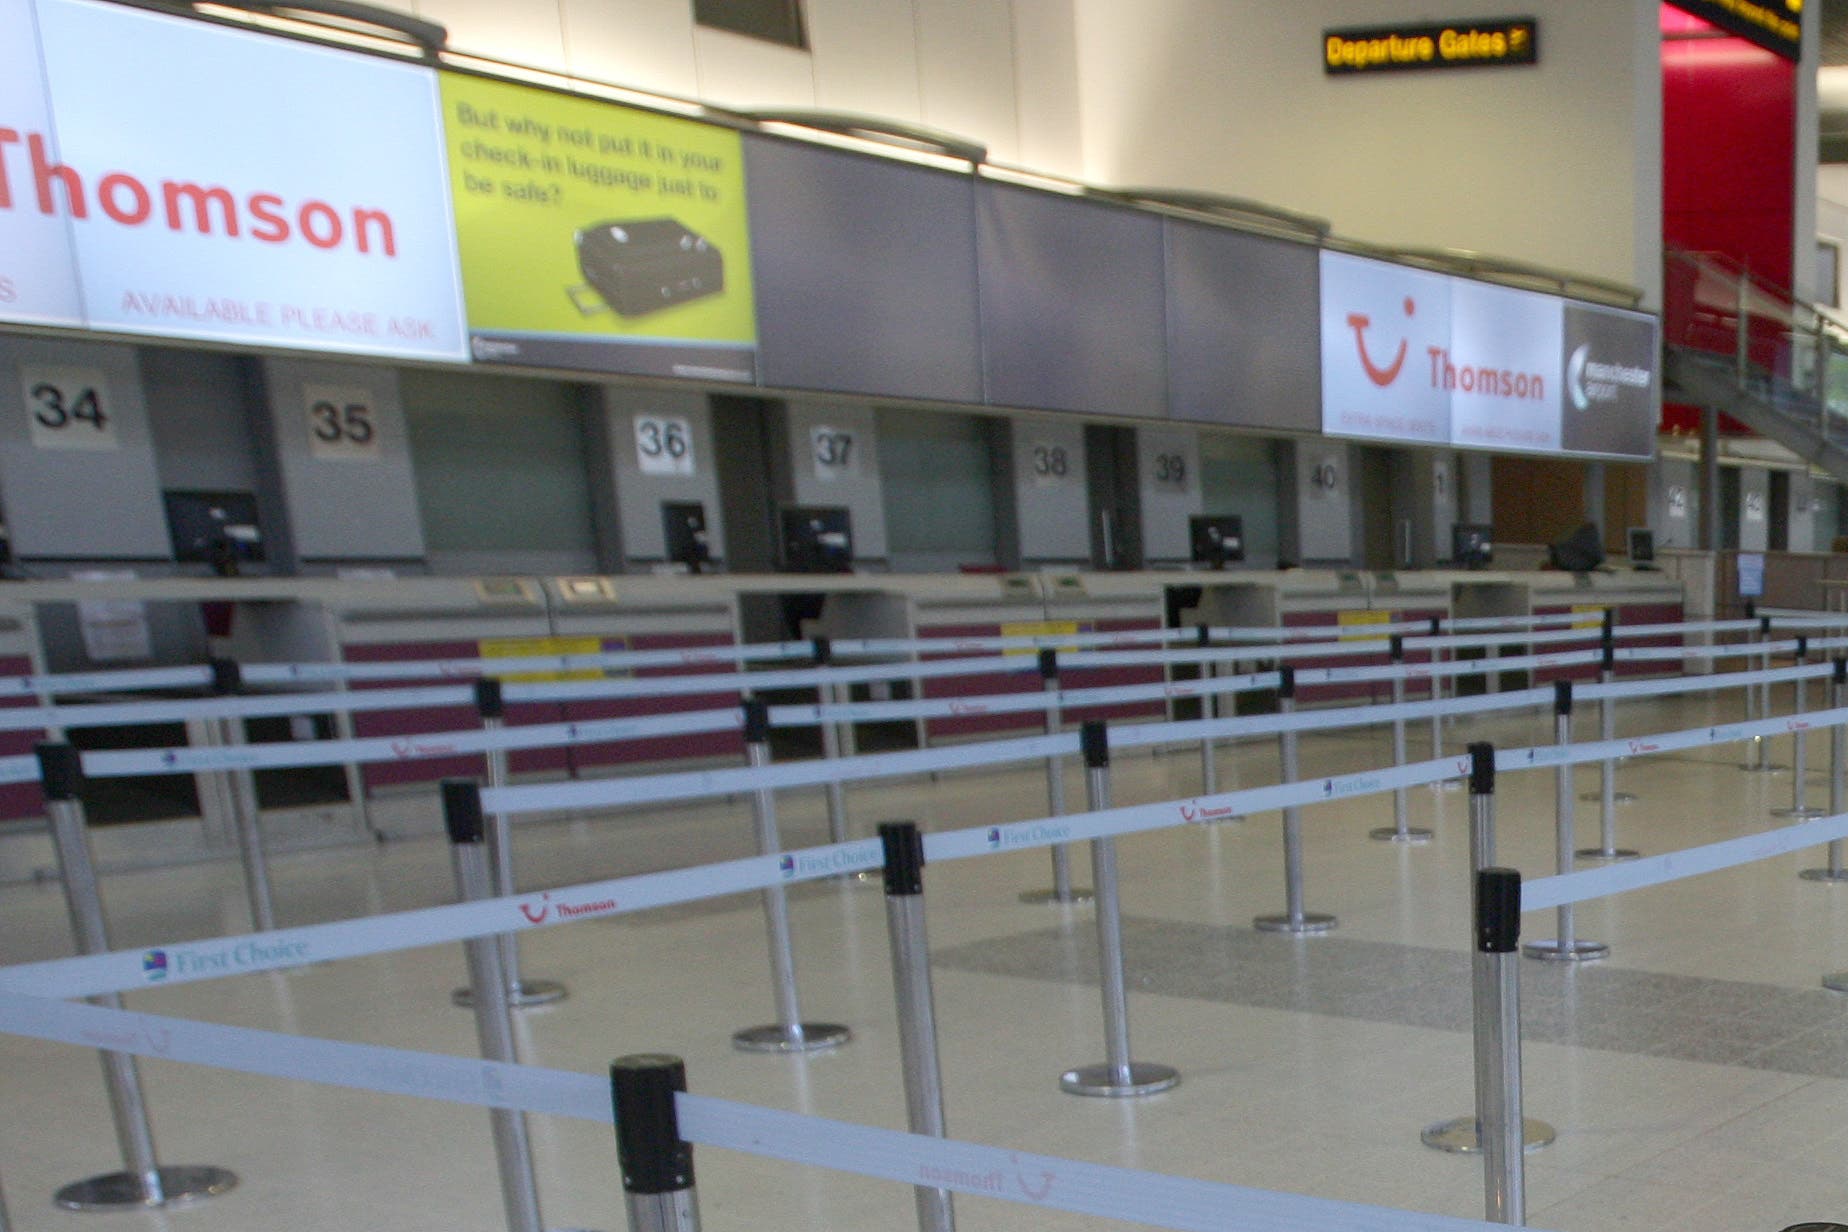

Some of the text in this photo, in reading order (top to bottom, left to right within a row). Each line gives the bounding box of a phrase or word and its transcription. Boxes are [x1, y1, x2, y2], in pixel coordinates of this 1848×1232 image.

[1327, 28, 1507, 69] Departure Gates
[457, 101, 721, 172] But why not put it in your
[460, 139, 718, 200] check-in luggage just to
[464, 171, 561, 202] be safe?
[0, 127, 396, 257] Thomson
[122, 290, 437, 341] AVAILABLE PLEASE ASK
[1426, 346, 1545, 400] Thomson
[30, 382, 107, 431] 34
[312, 400, 374, 444] 35
[638, 421, 686, 458] 36
[817, 434, 852, 465] 37
[1034, 446, 1067, 476] 38
[1155, 453, 1186, 482] 39
[1311, 463, 1337, 490] 40
[555, 898, 617, 918] Thomson
[175, 938, 306, 973] First Choice
